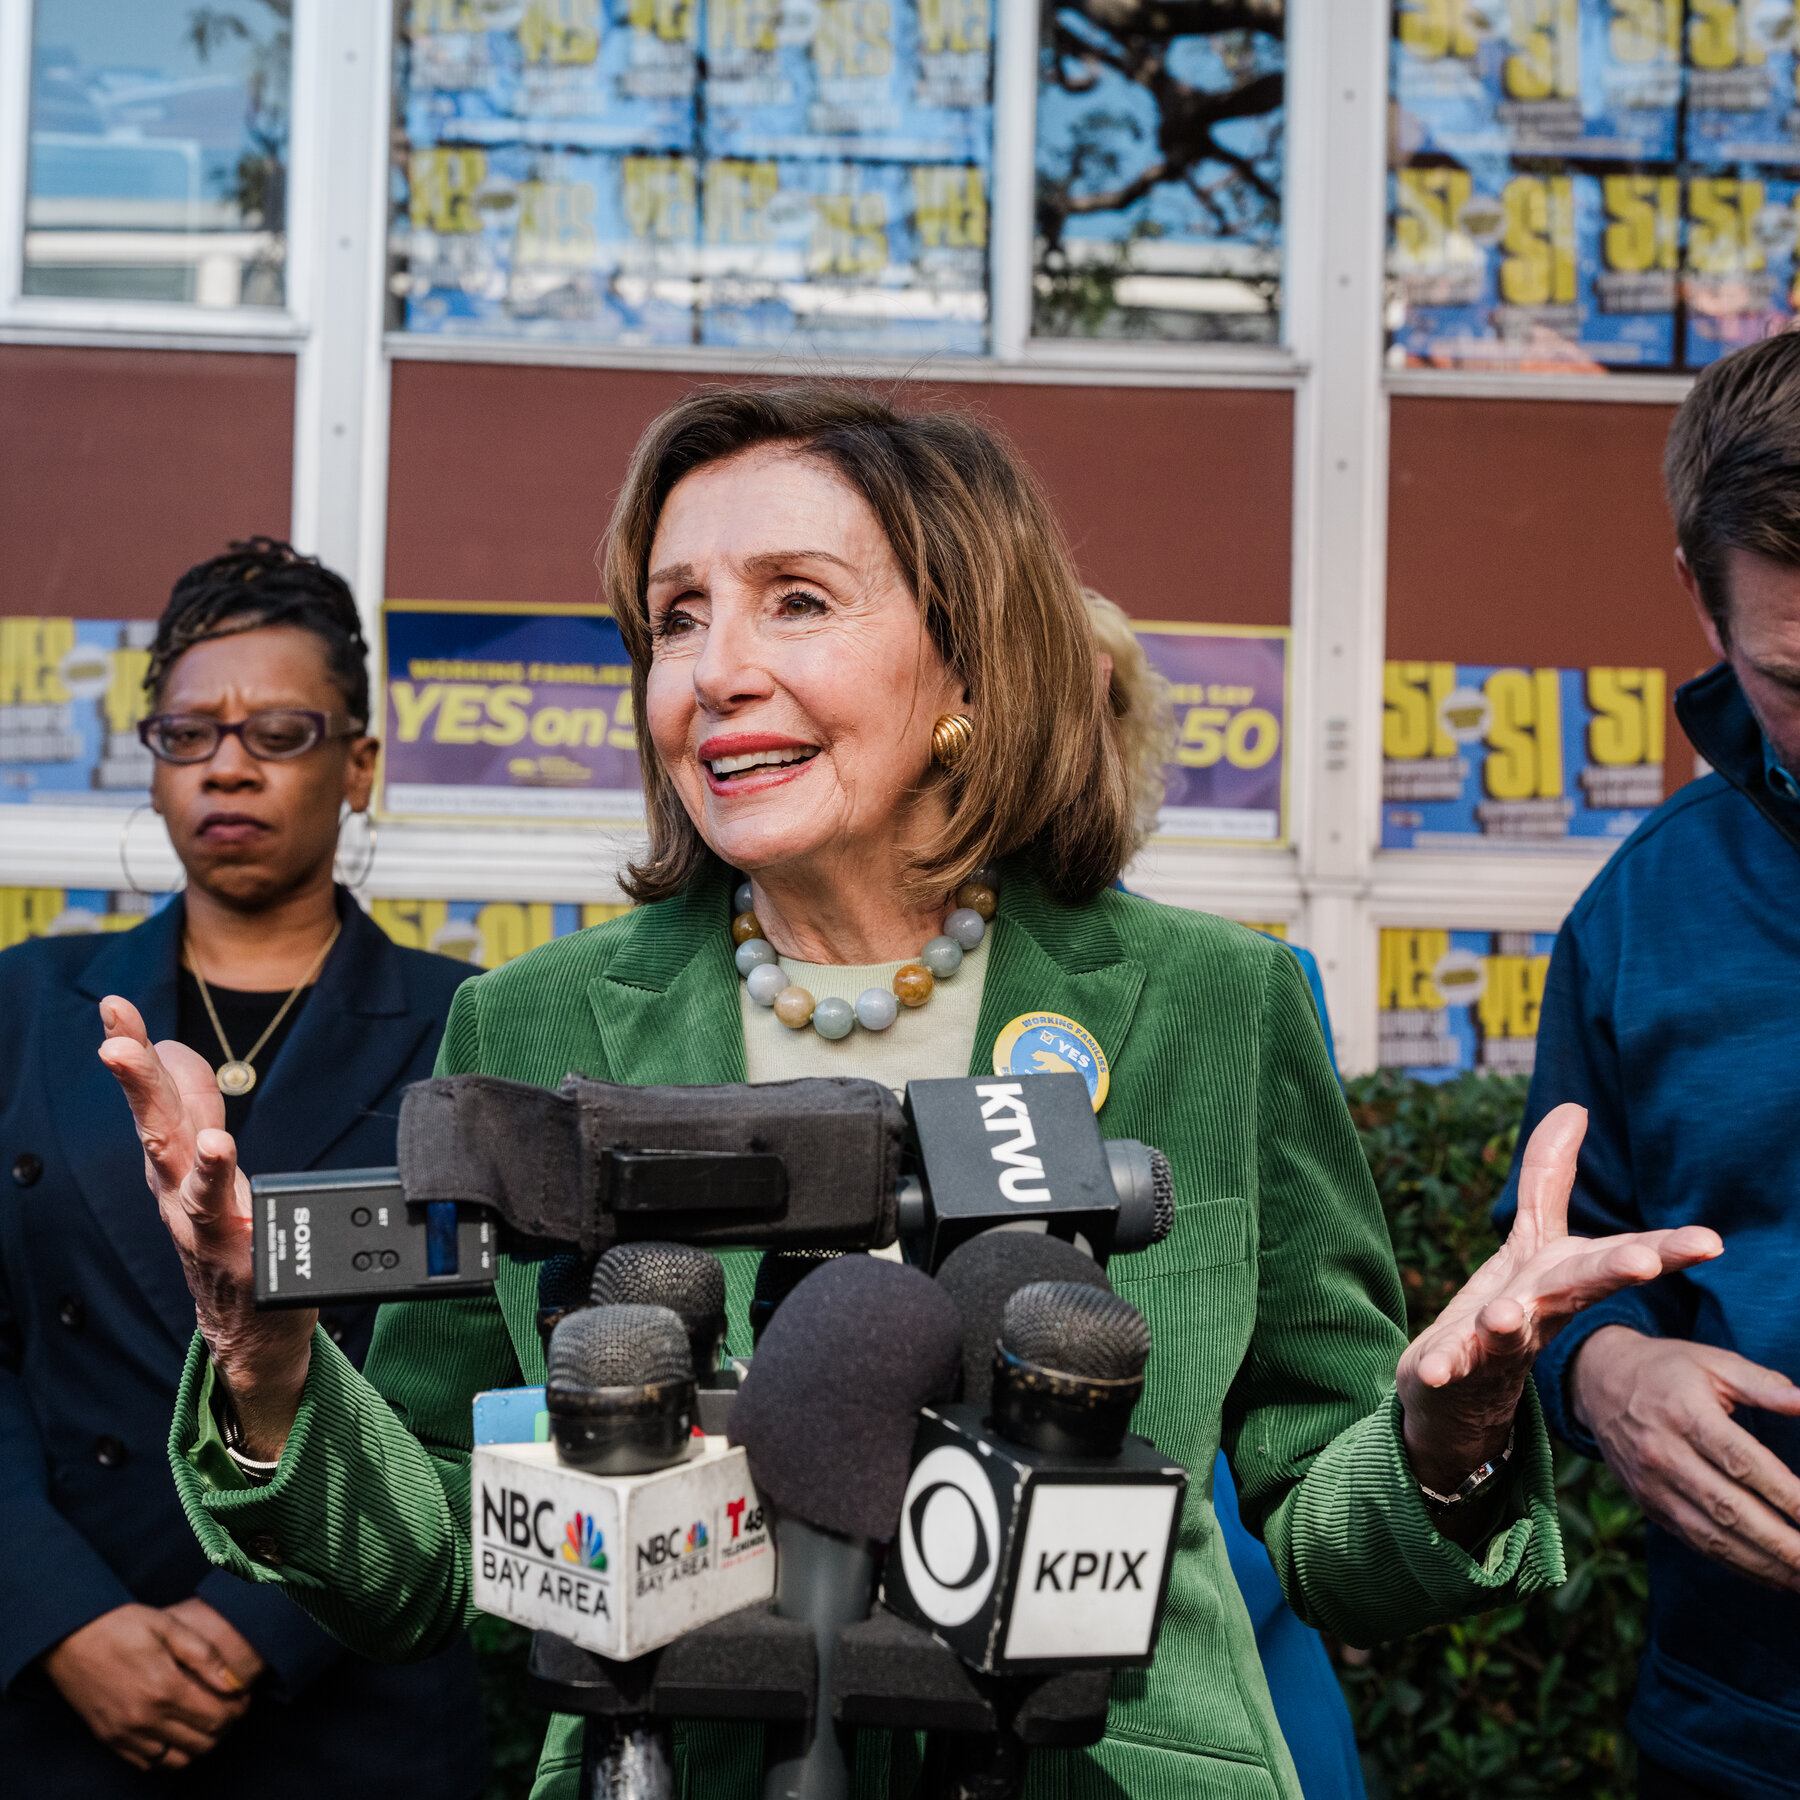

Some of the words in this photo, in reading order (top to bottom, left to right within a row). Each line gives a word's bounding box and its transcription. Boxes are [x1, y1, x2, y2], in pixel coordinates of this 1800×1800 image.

[390, 681, 534, 747] YES
[531, 707, 608, 747] on
[1174, 707, 1280, 770] 50
[1484, 667, 1563, 800] SI
[1021, 1016, 1074, 1030] WORKING
[1074, 1028, 1108, 1074] FAMILIES
[1058, 1039, 1091, 1068] YES
[975, 1083, 1052, 1203] KTVU
[294, 1206, 312, 1280] SONY
[482, 1482, 556, 1559] NBC
[636, 1528, 683, 1573] NBC
[482, 1551, 531, 1592] BAY
[538, 1573, 612, 1622] AREA
[636, 1573, 664, 1598] BAY
[669, 1557, 709, 1582] AREA
[1034, 1551, 1148, 1593] KPIX
